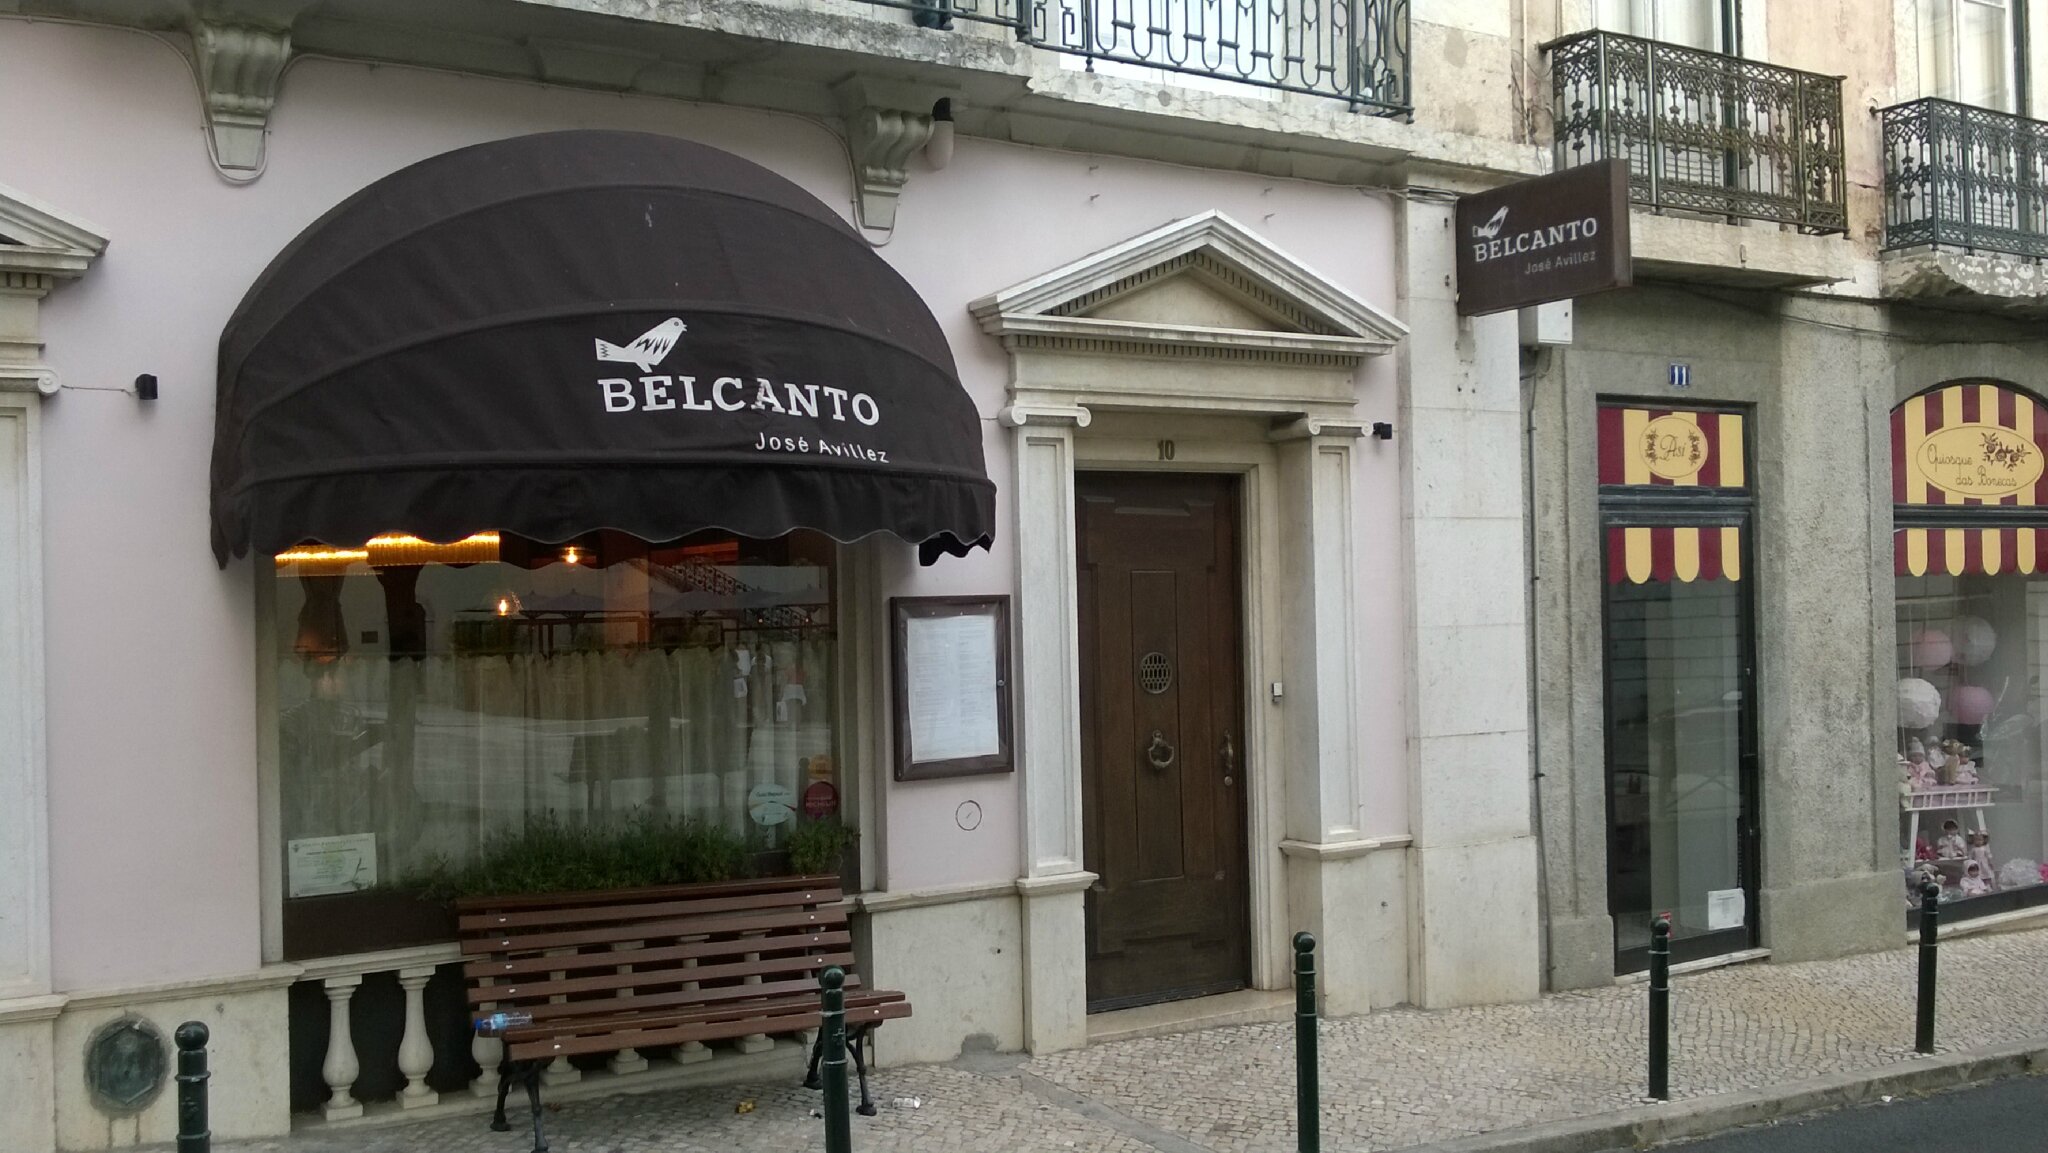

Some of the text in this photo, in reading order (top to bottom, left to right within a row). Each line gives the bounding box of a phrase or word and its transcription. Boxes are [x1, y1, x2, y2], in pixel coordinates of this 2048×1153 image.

[1473, 217, 1598, 263] BELCANTO
[1525, 250, 1596, 275] José Avillez
[1674, 365, 1687, 386] 11
[597, 375, 880, 426] BELCANTO
[755, 431, 890, 464] José Avillez
[1157, 439, 1175, 461] 10
